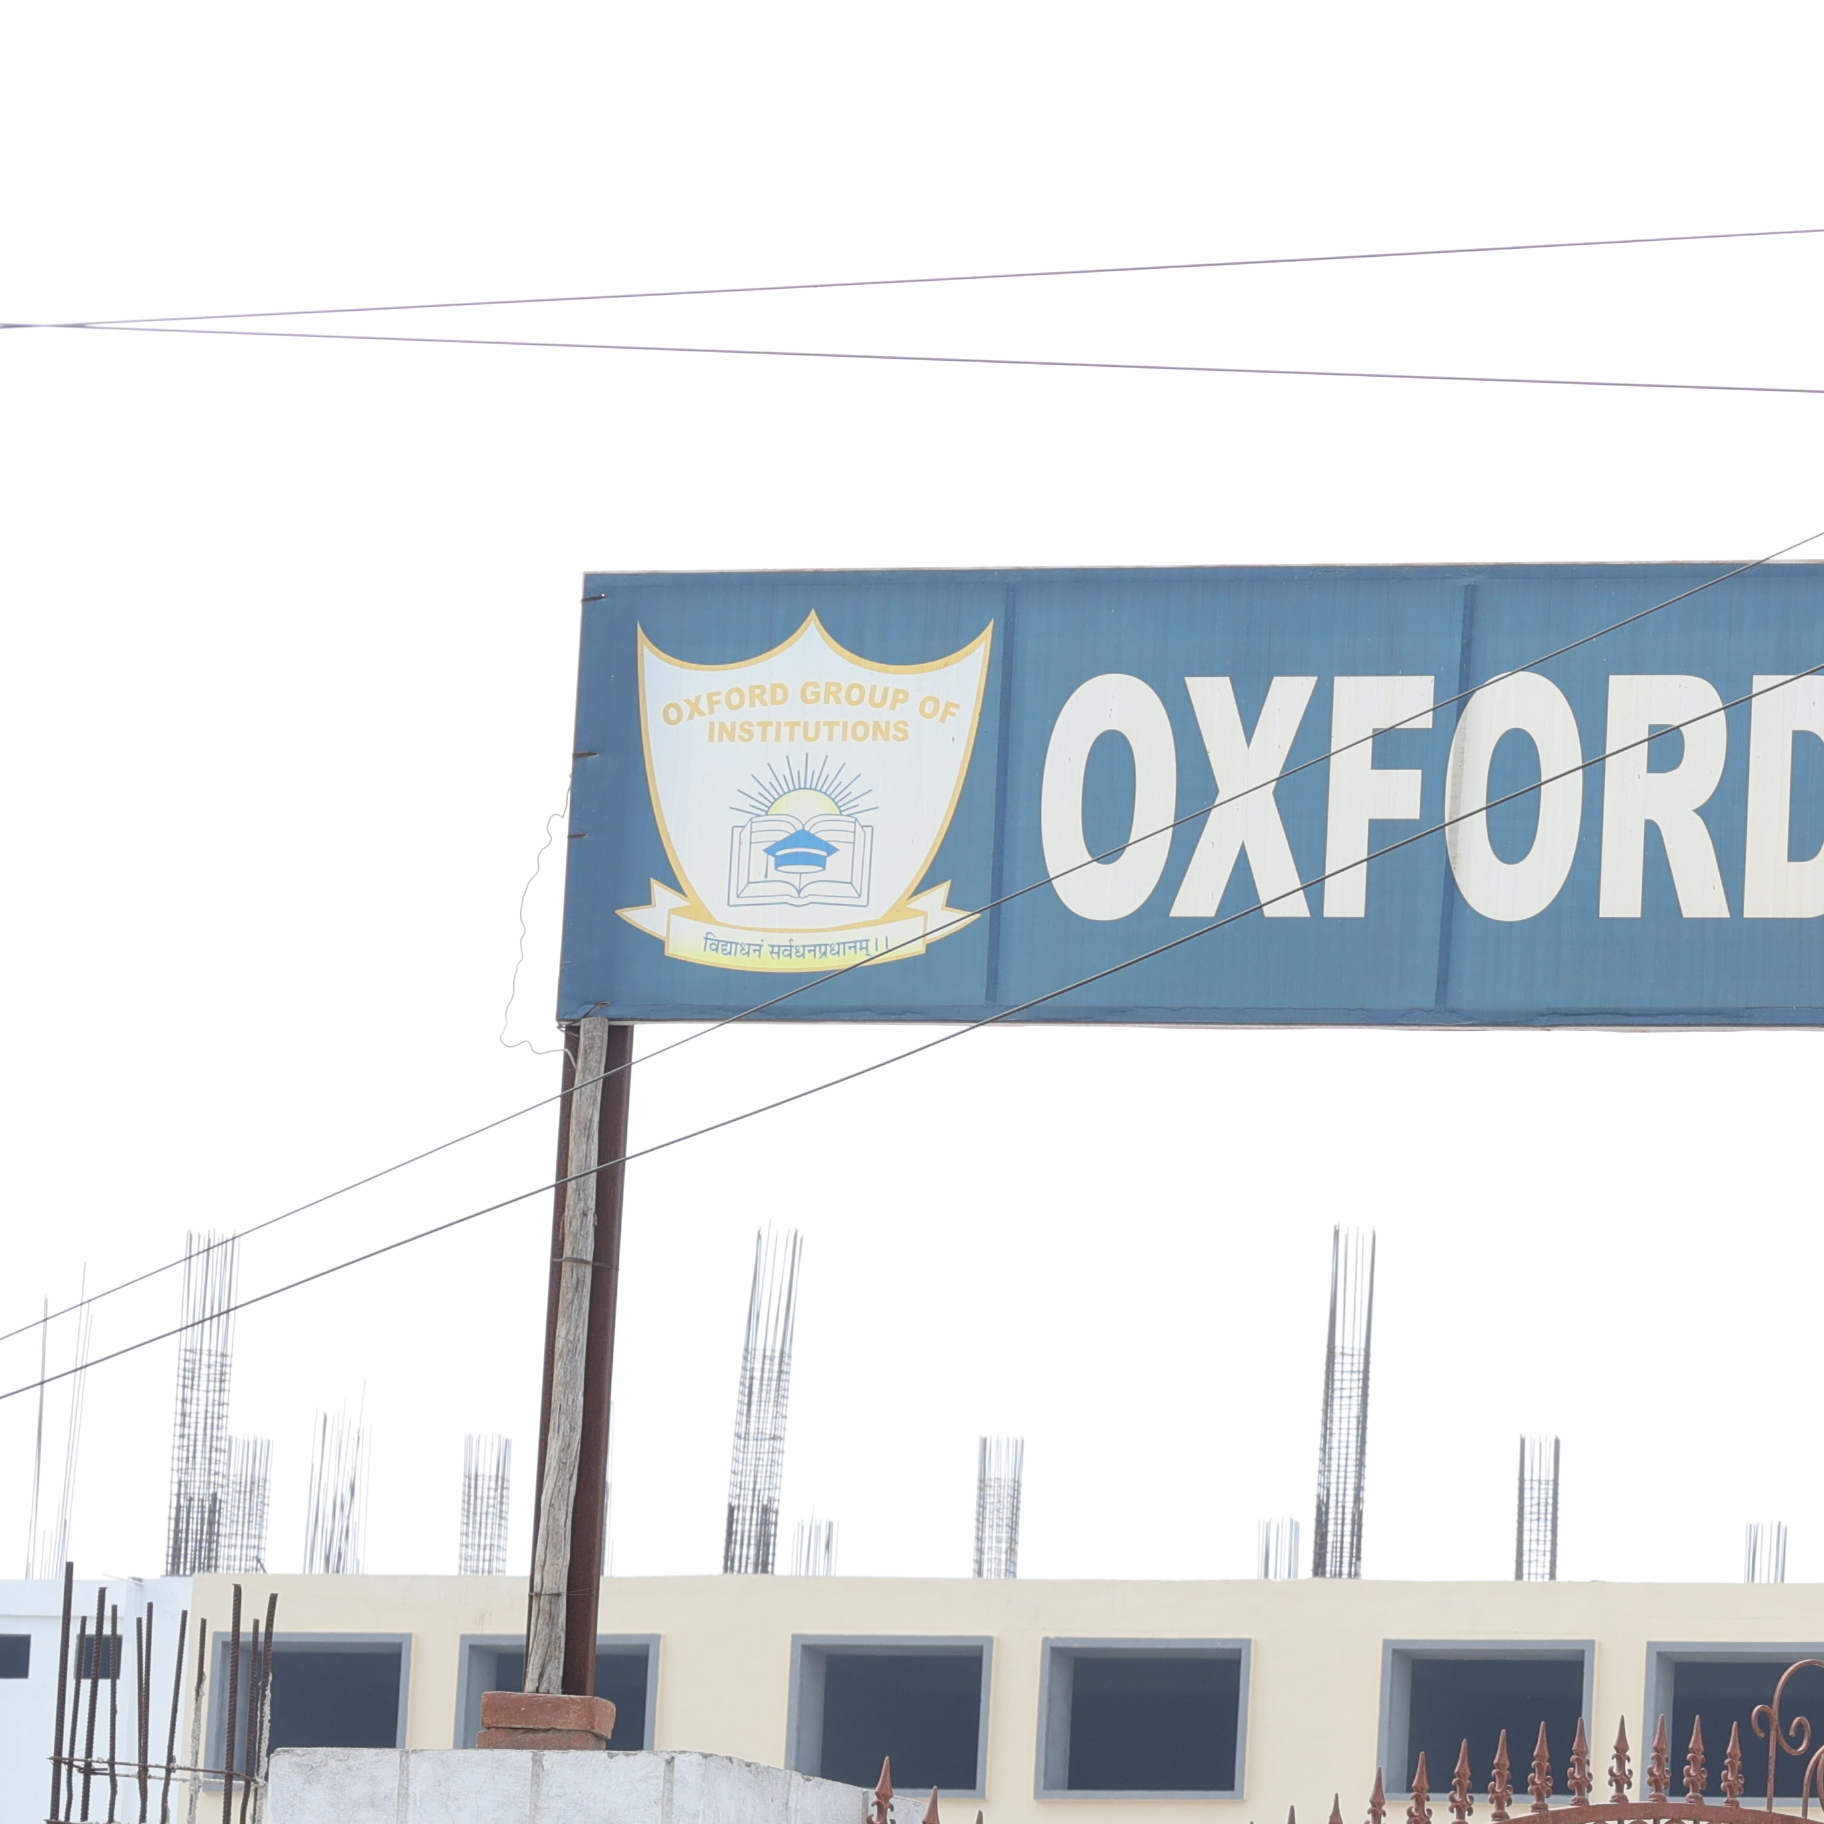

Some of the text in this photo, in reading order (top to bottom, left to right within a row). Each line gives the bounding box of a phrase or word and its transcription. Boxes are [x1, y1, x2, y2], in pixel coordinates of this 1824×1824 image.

[662, 681, 961, 726] OXFORD GROUP OF
[708, 720, 910, 743] INSTITUTIONS
